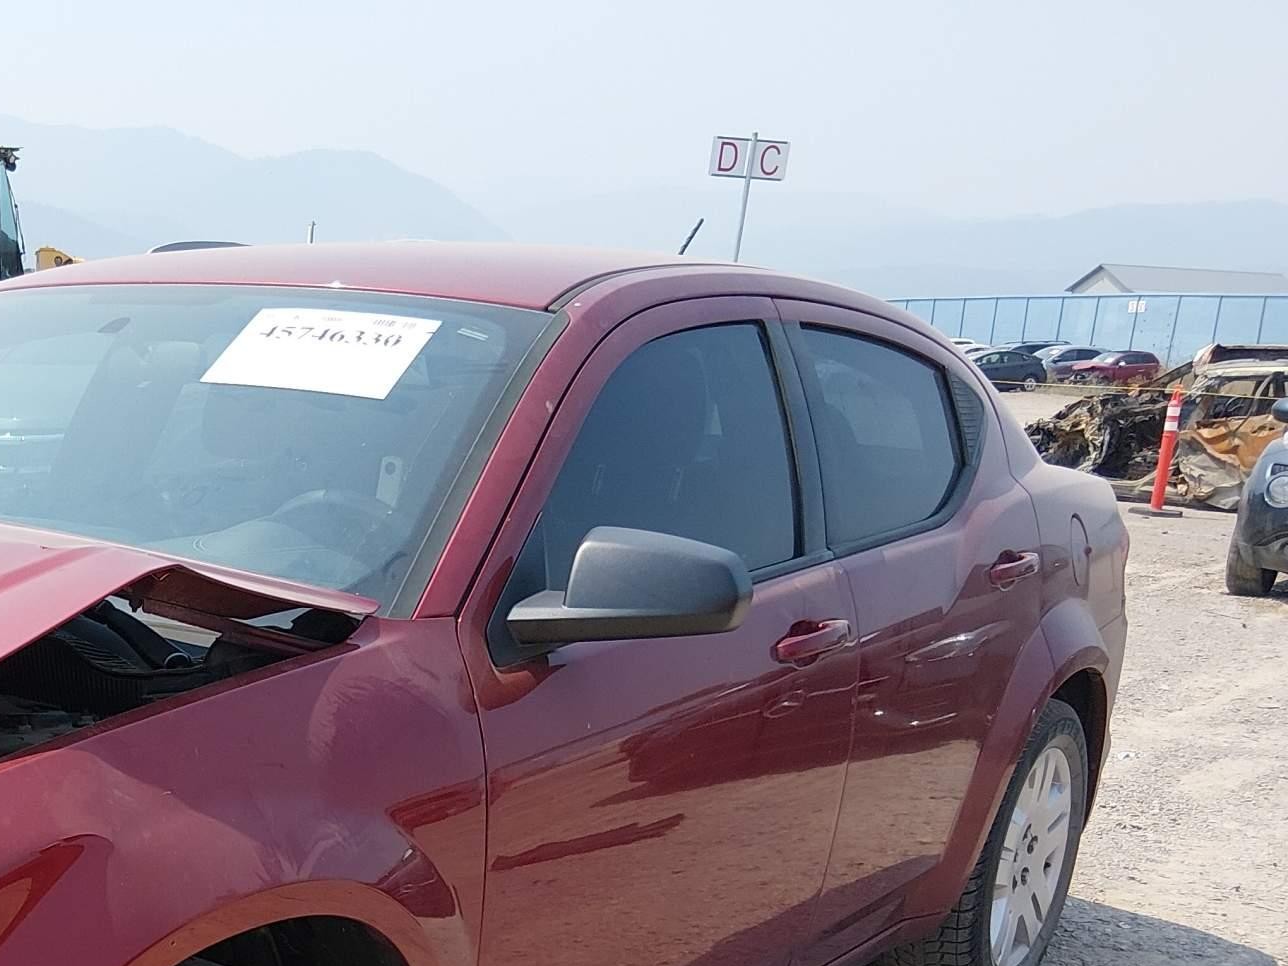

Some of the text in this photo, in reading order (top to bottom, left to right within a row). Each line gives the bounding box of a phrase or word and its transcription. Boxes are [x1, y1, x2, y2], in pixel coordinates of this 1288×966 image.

[717, 141, 738, 172] D
[760, 144, 781, 176] C
[259, 324, 403, 348] 45746330
